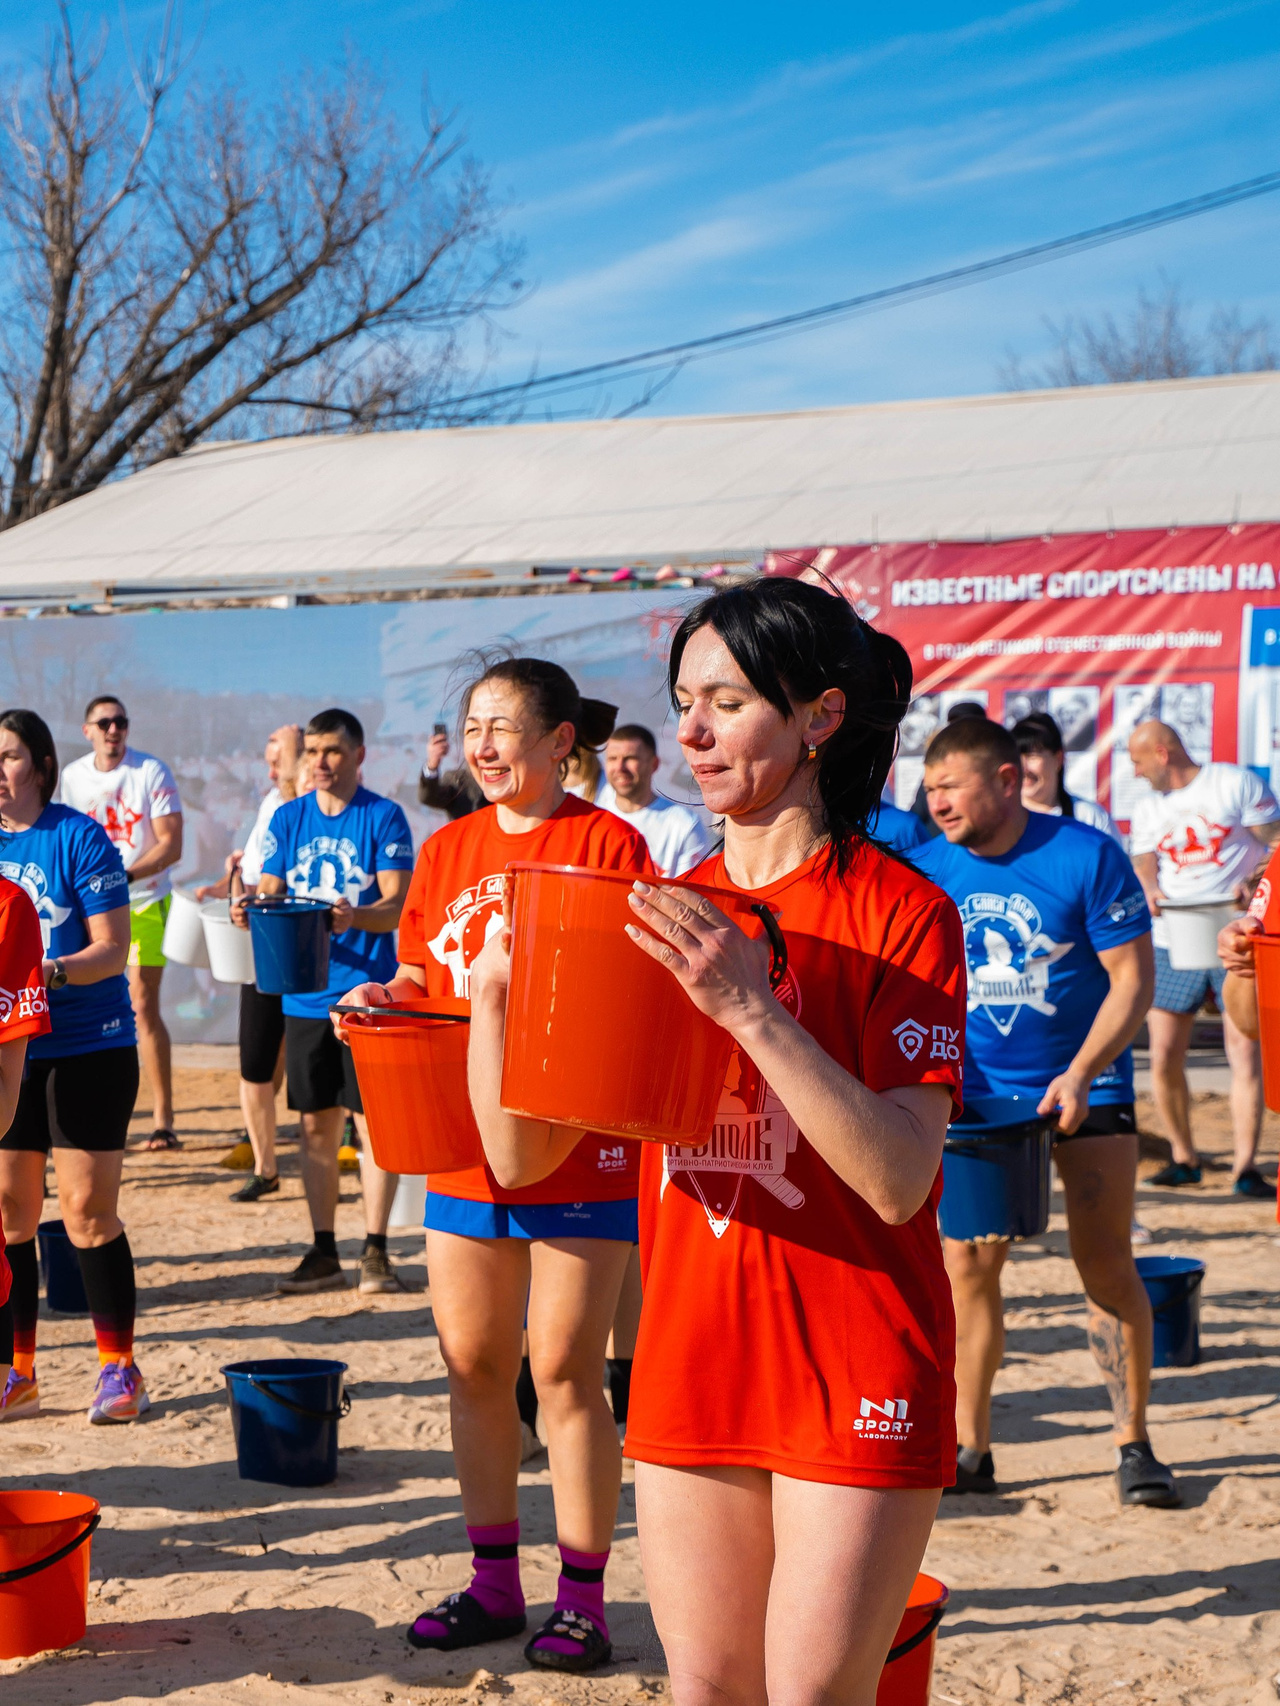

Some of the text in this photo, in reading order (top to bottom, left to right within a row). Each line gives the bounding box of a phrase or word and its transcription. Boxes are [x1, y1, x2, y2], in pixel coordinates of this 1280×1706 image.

[891, 562, 1276, 607] ИЗВЕСТНЫЕ СПОРТСМЕНЫ НА
[17, 985, 47, 1002] ПУТ
[932, 1024, 960, 1043] ПУ
[929, 1041, 960, 1060] ДО
[597, 1159, 628, 1169] SPORT
[752, 1162, 774, 1171] КЛУБ
[852, 1418, 914, 1433] SPORT
[858, 1432, 908, 1441] LABORATORY
